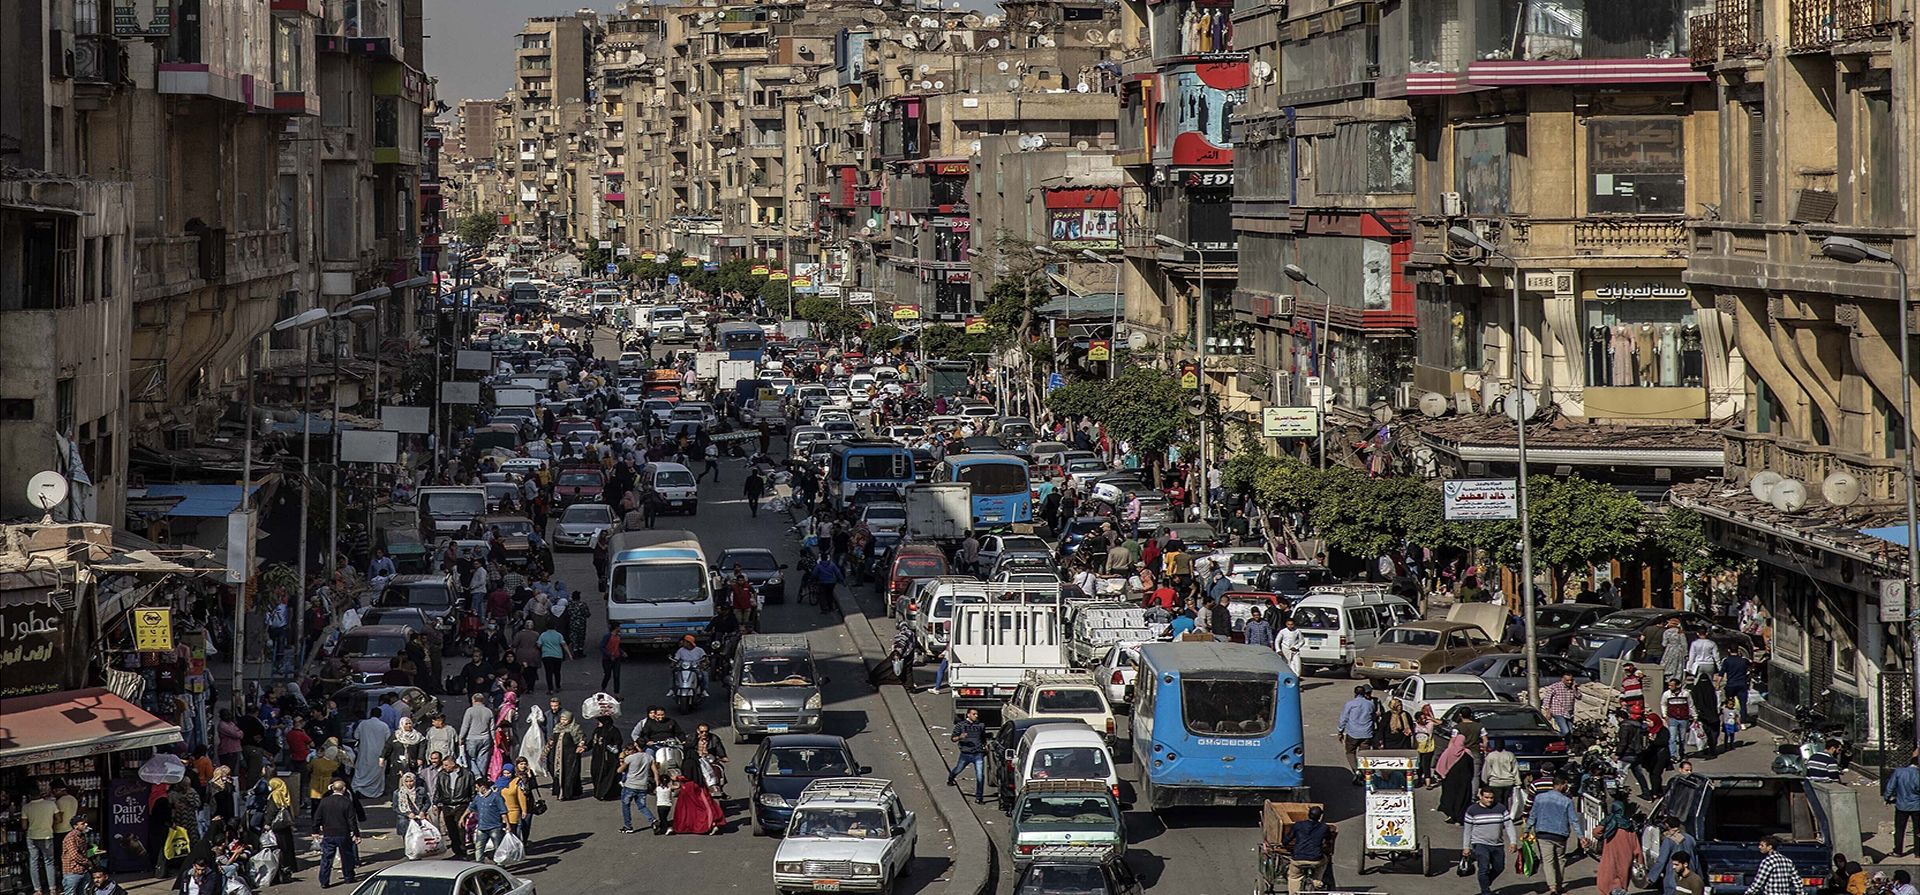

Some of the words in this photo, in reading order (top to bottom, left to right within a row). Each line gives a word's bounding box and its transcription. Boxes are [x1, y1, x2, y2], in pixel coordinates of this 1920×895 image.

[1595, 281, 1651, 299] للعبايات
[1651, 282, 1688, 297] مسك
[10, 610, 59, 641] عطور
[112, 803, 146, 815] Dairy
[114, 814, 145, 825] Milk
